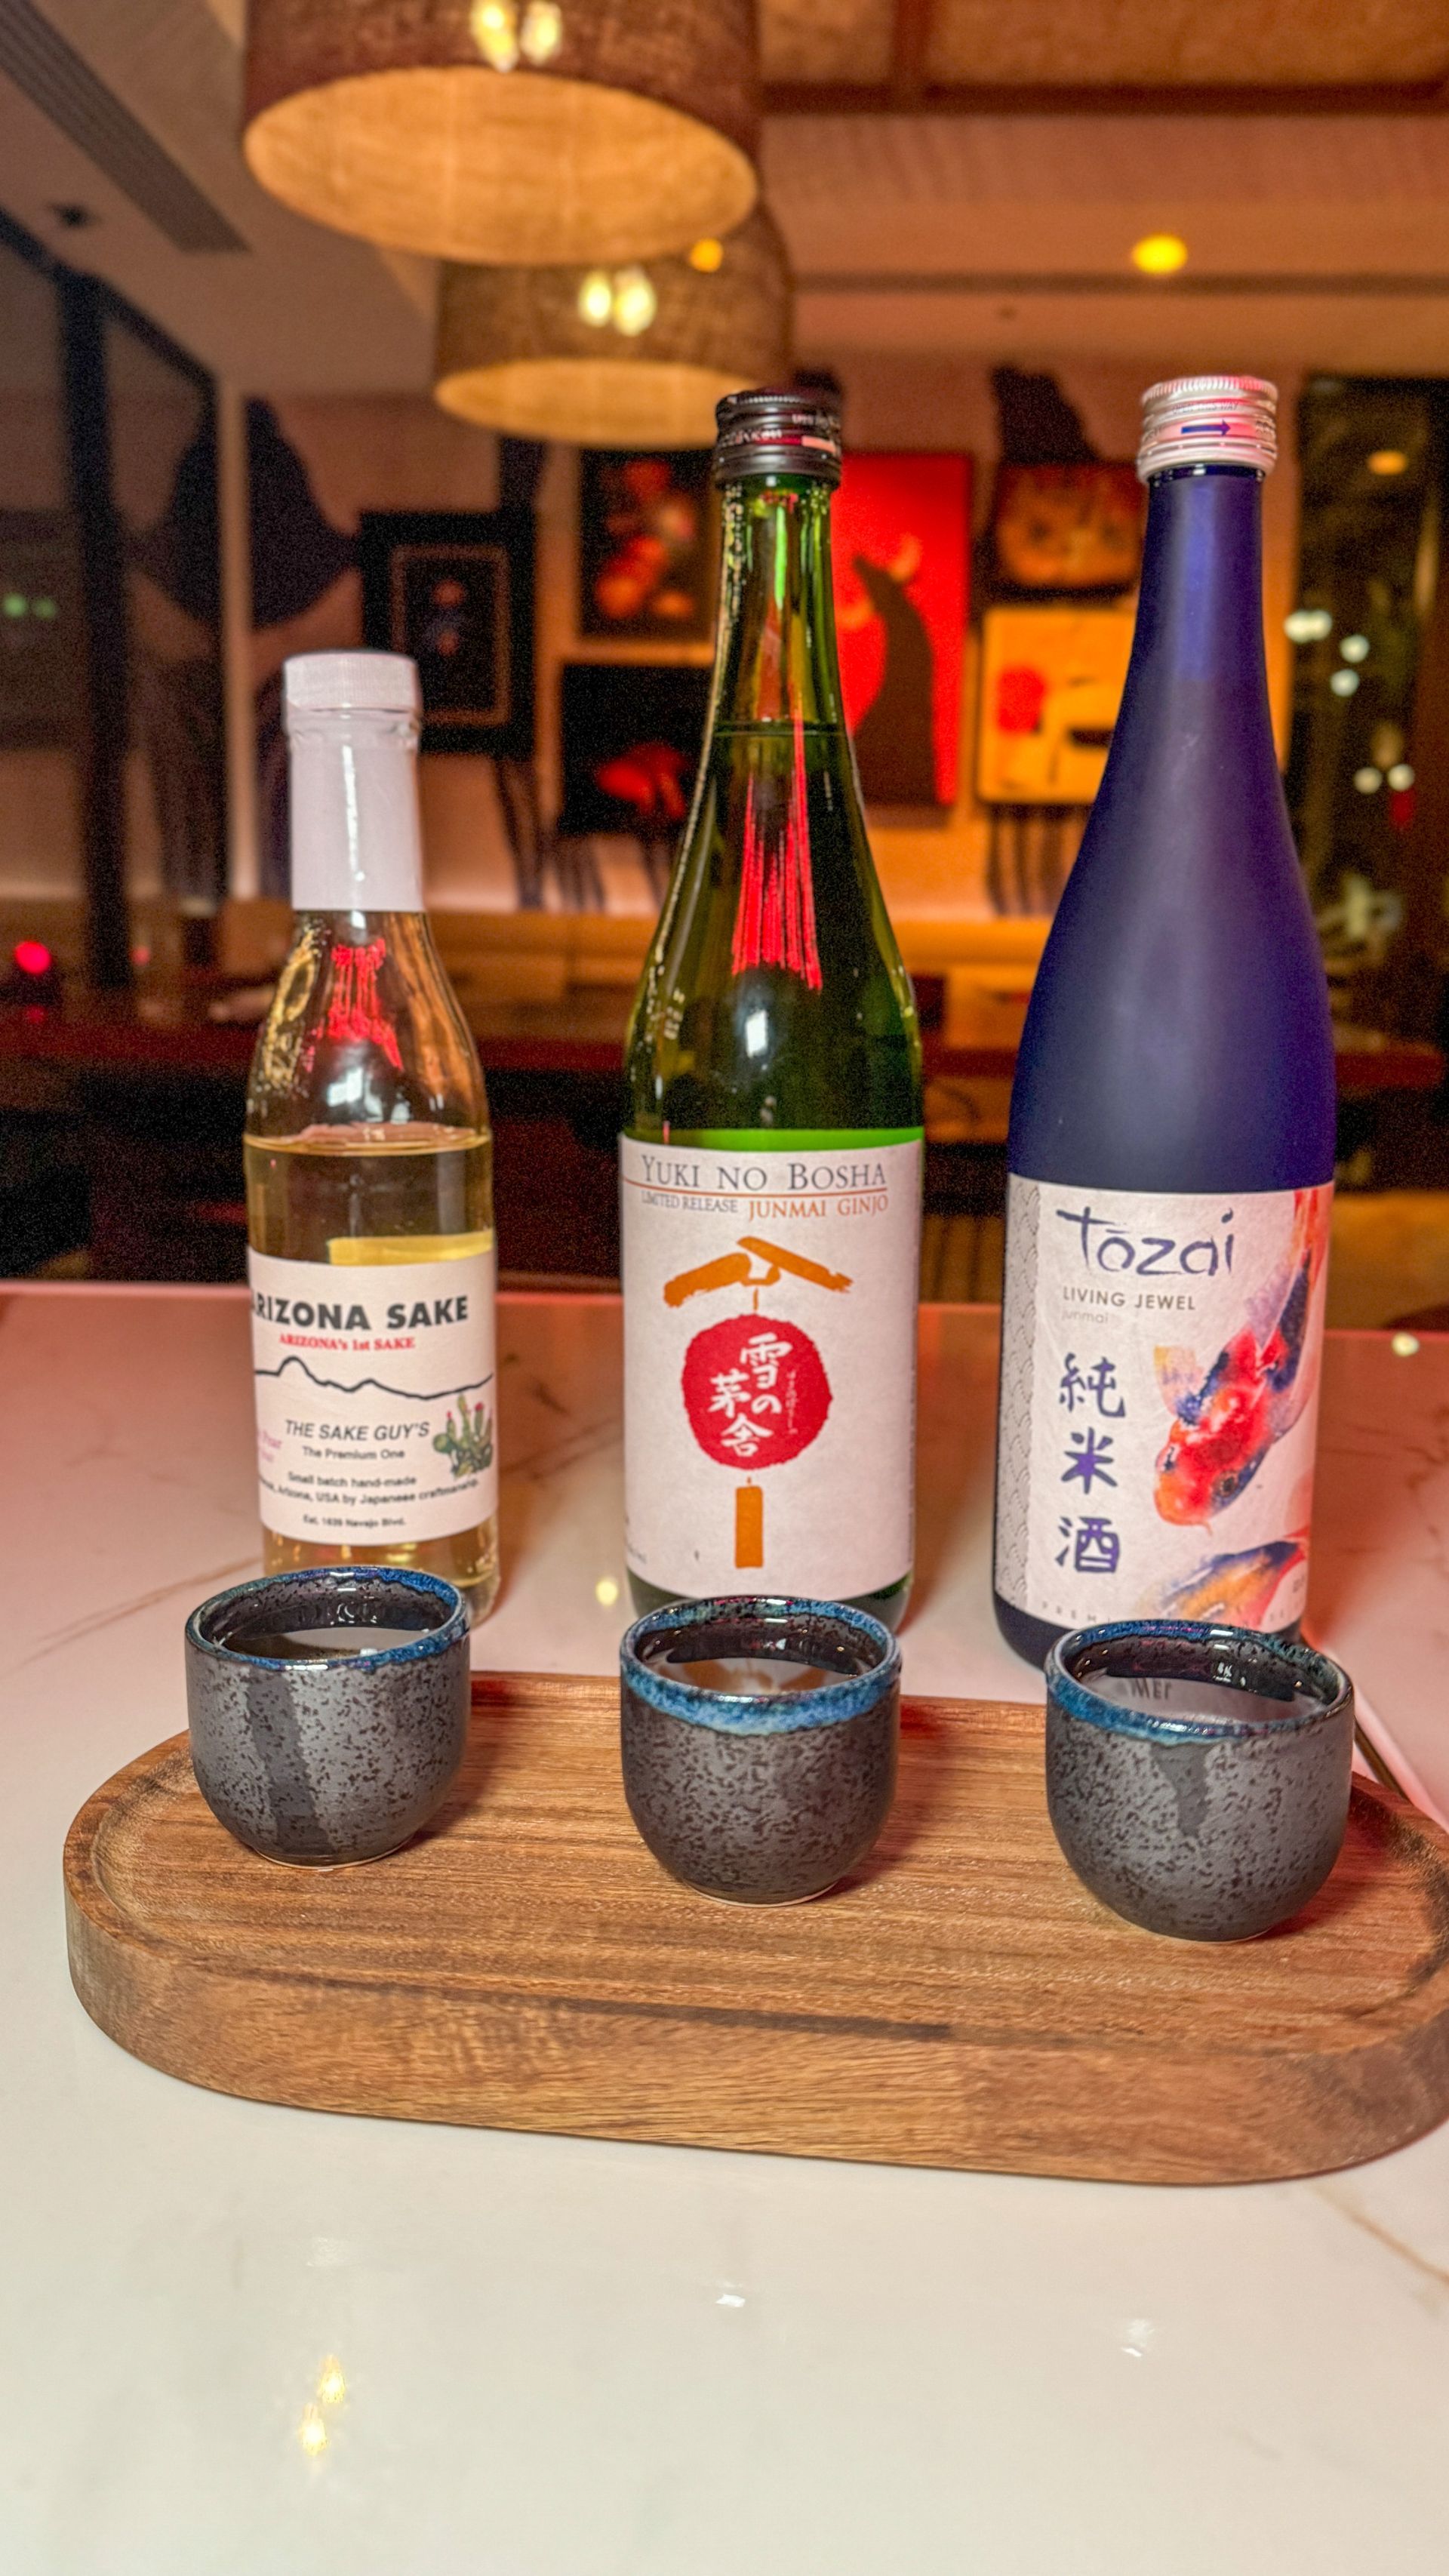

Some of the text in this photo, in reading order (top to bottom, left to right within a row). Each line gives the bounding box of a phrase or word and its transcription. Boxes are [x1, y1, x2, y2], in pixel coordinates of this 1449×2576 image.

[641, 1154, 886, 1191] YUKI NO BOSHA
[682, 1196, 738, 1213] RELEASE
[749, 1200, 826, 1222] JUNMAI
[837, 1194, 889, 1217] GINJO
[1063, 1286, 1196, 1312] LIVING JEWEL
[251, 1291, 468, 1331] RIZONA SAKE
[1060, 1308, 1109, 1325] junmai
[352, 1339, 370, 1351] 1st
[374, 1337, 415, 1351] SAKE
[285, 1418, 430, 1441] THE SAKE GUY'S
[302, 1445, 405, 1460] The Premium One
[1054, 1352, 1127, 1574] 純米酒
[288, 1472, 315, 1485] Small
[317, 1476, 348, 1487] batch
[315, 1491, 340, 1503] USA
[343, 1494, 356, 1507] by
[360, 1492, 415, 1506] Japanese
